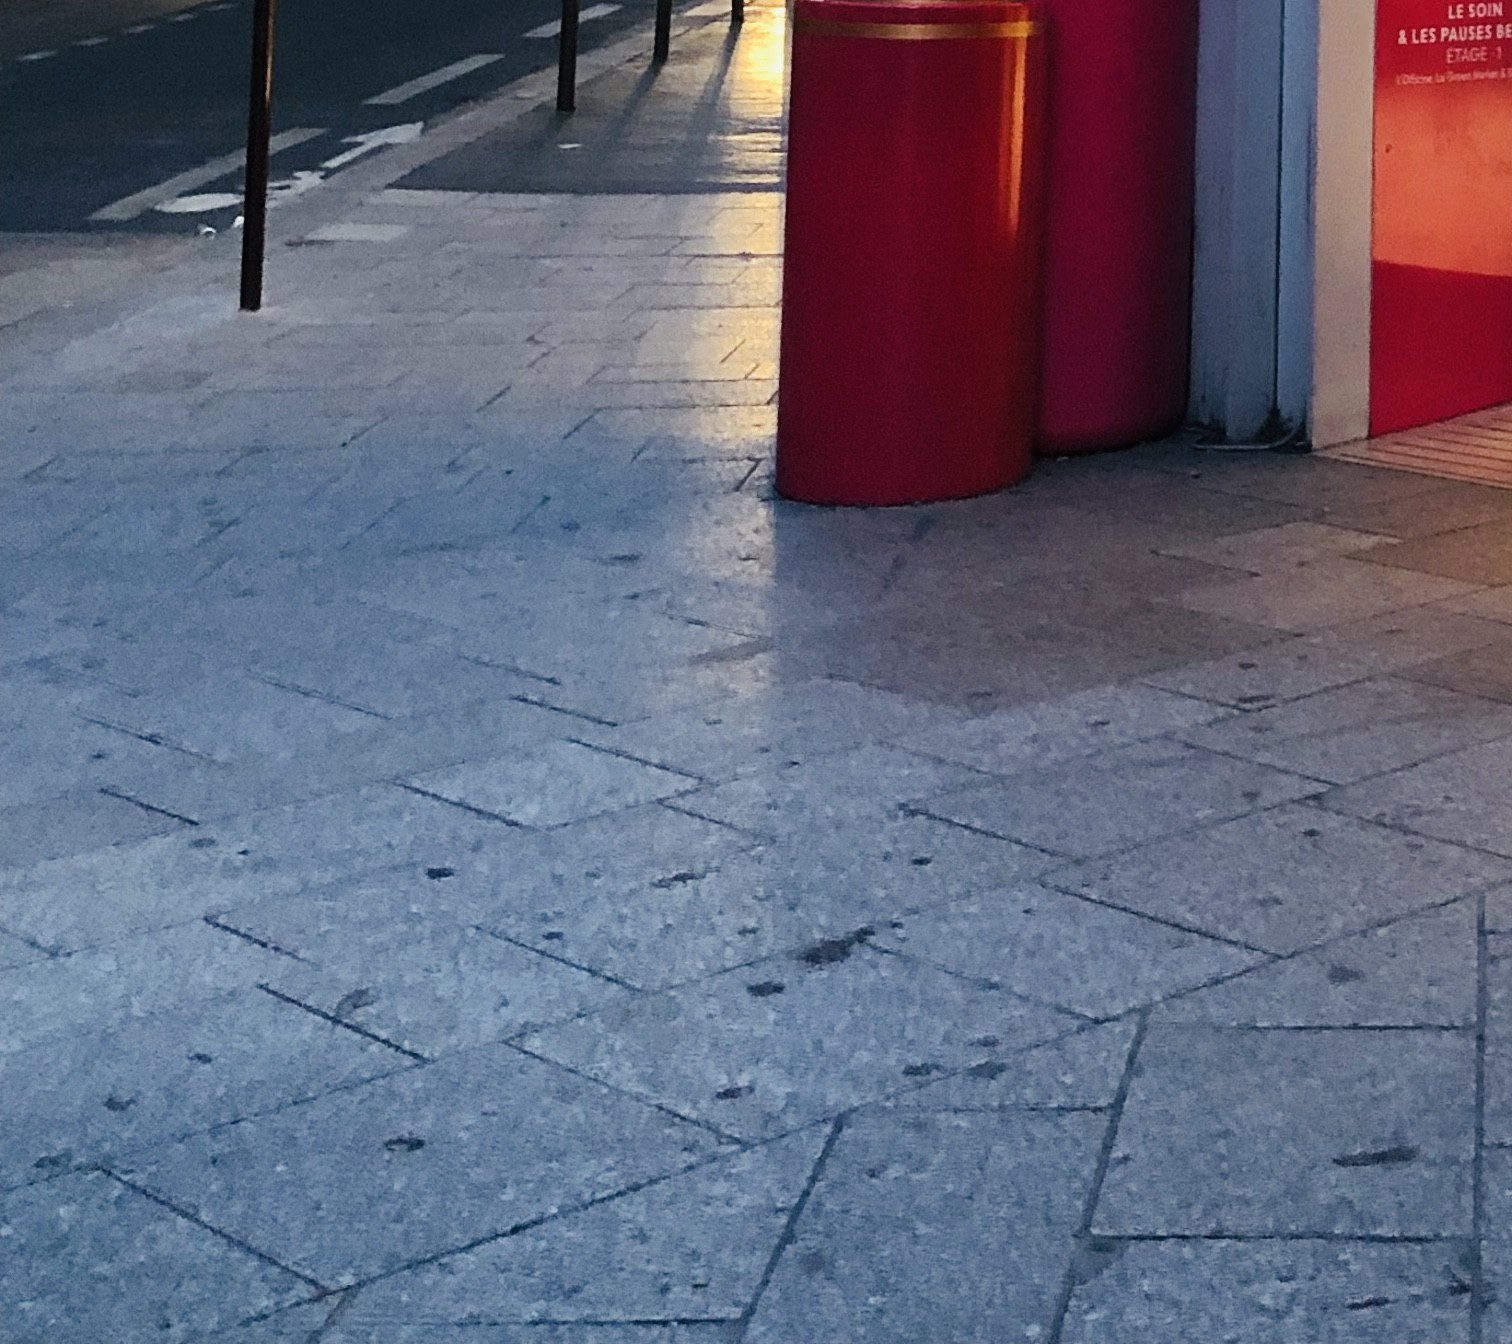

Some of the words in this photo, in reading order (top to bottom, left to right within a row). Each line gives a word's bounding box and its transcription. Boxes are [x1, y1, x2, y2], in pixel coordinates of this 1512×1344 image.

[1448, 4, 1464, 20] LE
[1468, 2, 1503, 18] SOIN
[1398, 29, 1407, 45] &
[1411, 28, 1436, 45] LES
[1440, 25, 1492, 43] PAUSES
